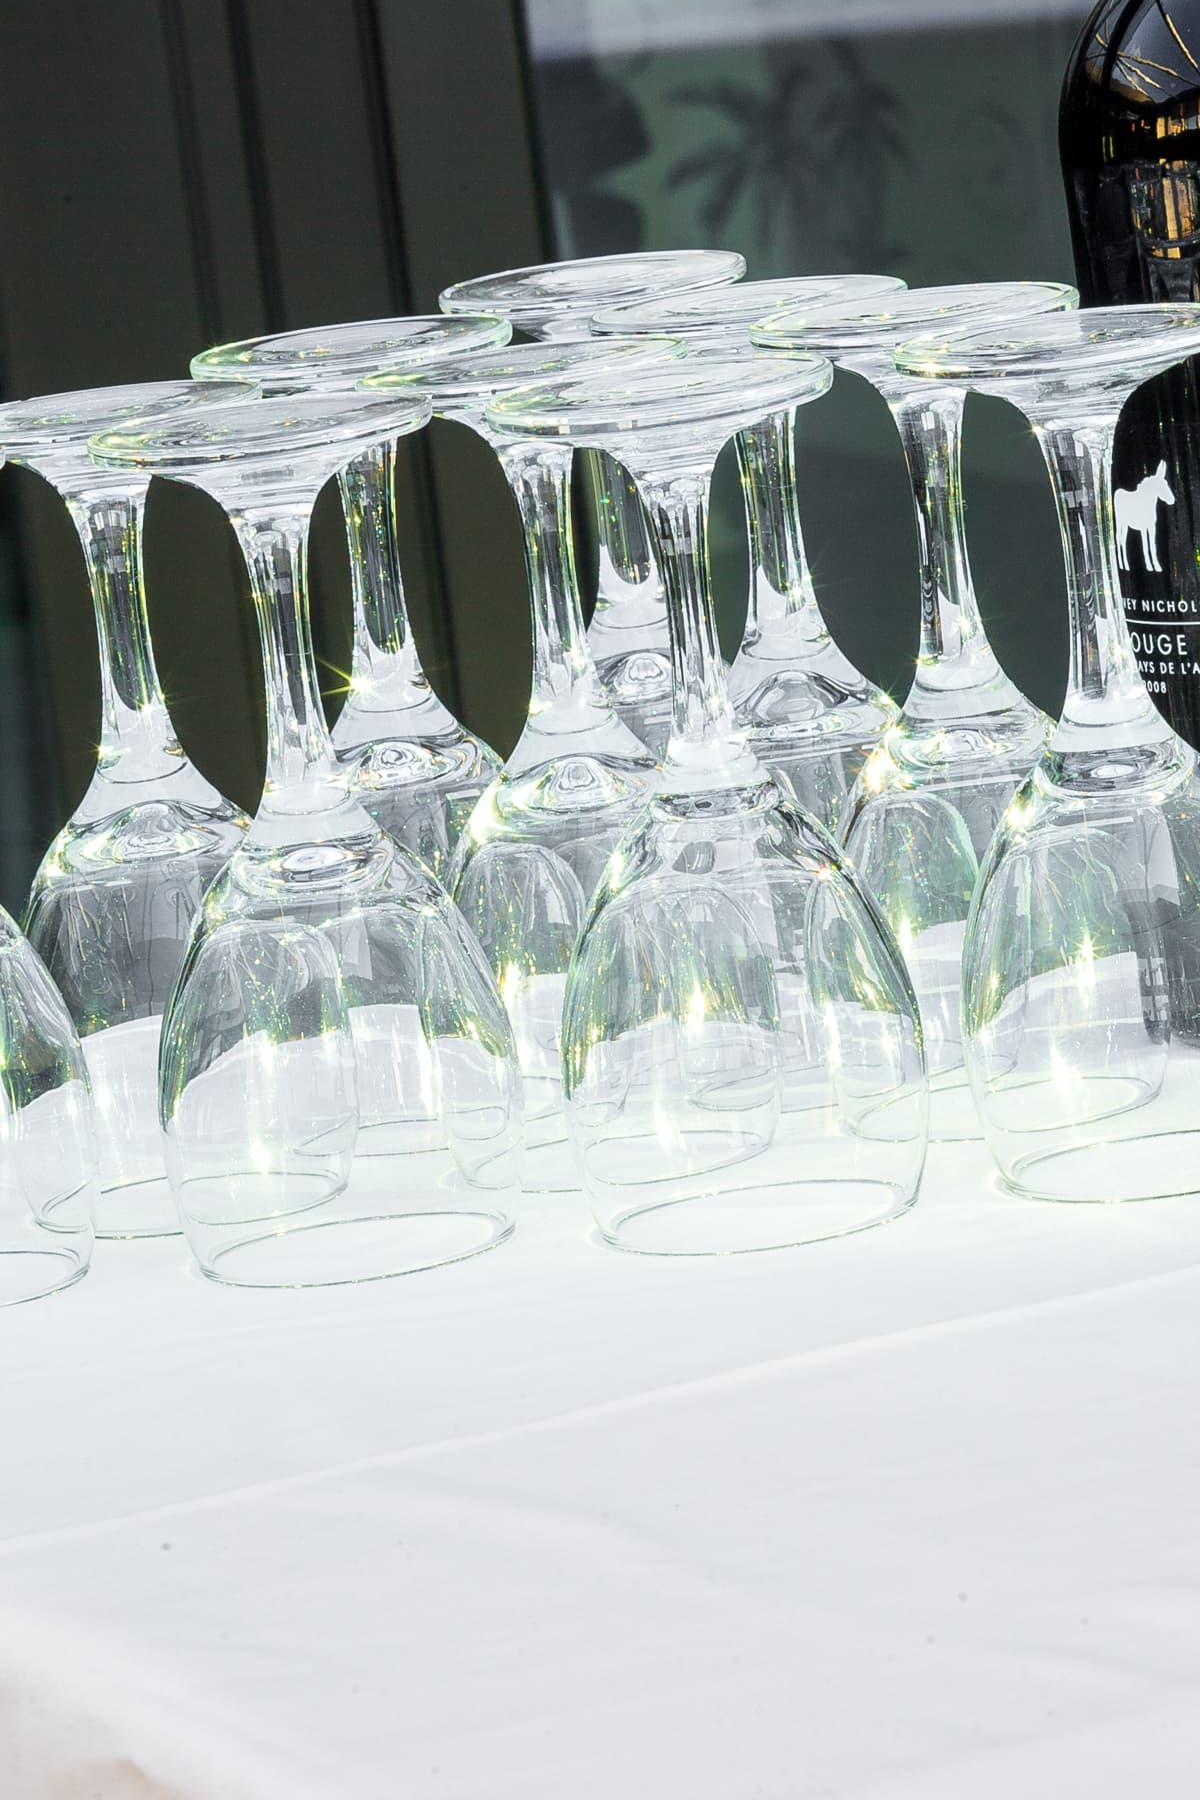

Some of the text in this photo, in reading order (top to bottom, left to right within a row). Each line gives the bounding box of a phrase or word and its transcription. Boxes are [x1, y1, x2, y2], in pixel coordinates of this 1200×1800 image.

[1130, 631, 1188, 655] OUGE
[1138, 660, 1155, 674] AYS
[1159, 662, 1175, 675] DE
[1144, 680, 1167, 694] 008
